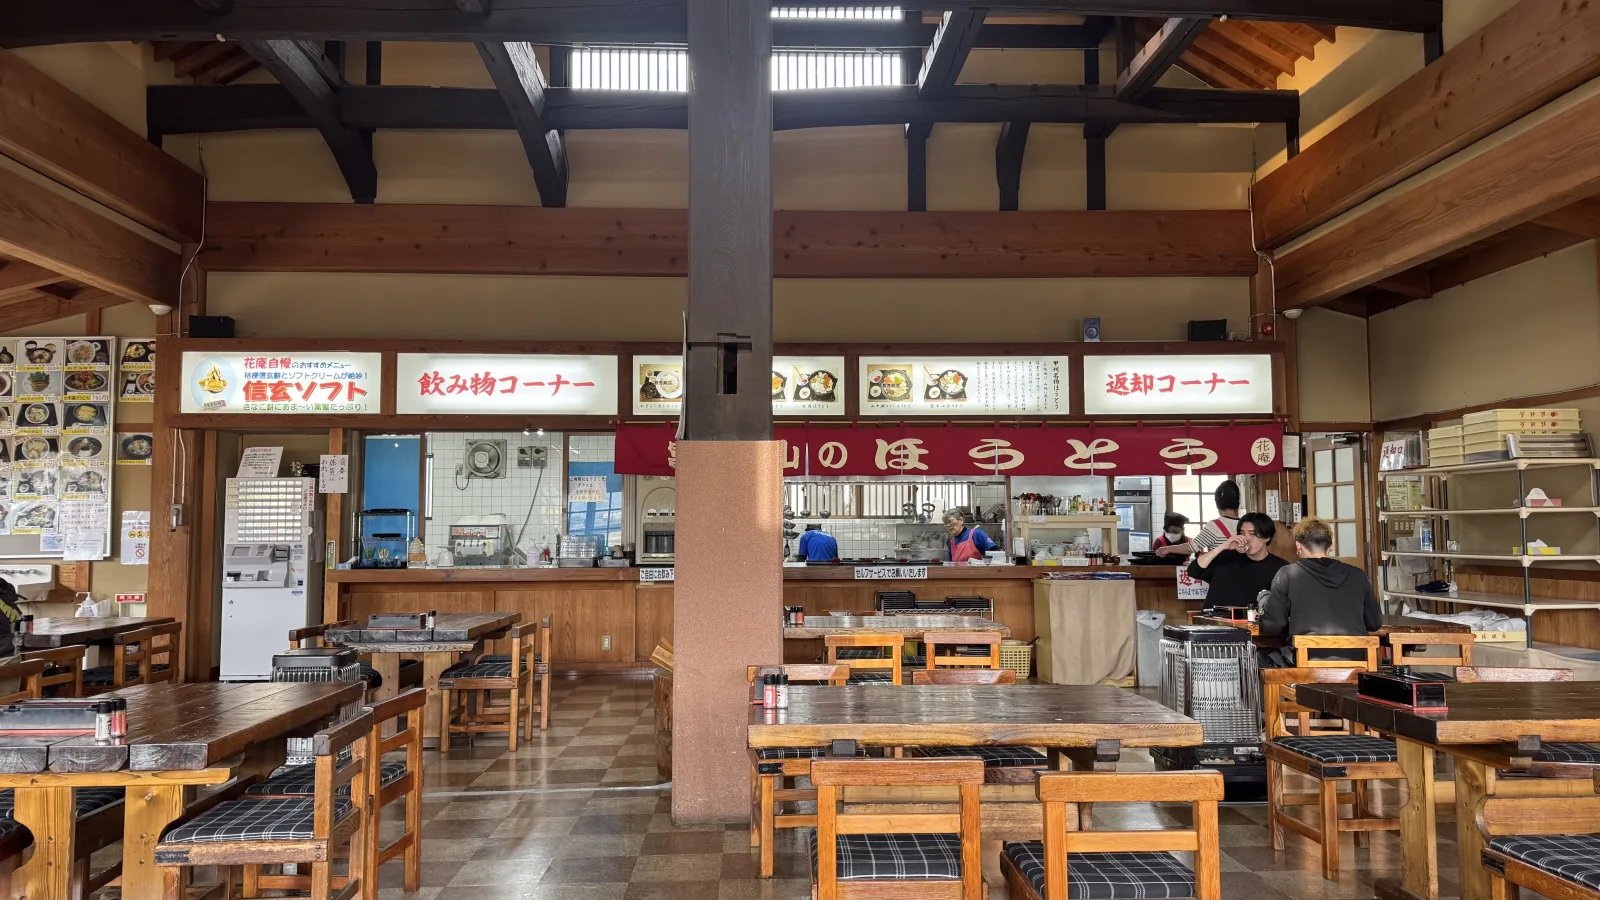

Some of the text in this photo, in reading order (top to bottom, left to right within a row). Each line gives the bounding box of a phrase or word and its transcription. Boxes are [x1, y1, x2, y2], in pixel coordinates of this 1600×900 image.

[242, 380, 368, 402] 信玄ソフト
[417, 370, 595, 396] 飲み物コーナー
[1105, 371, 1250, 396] 返却コーナー
[1256, 440, 1271, 463] 花庵
